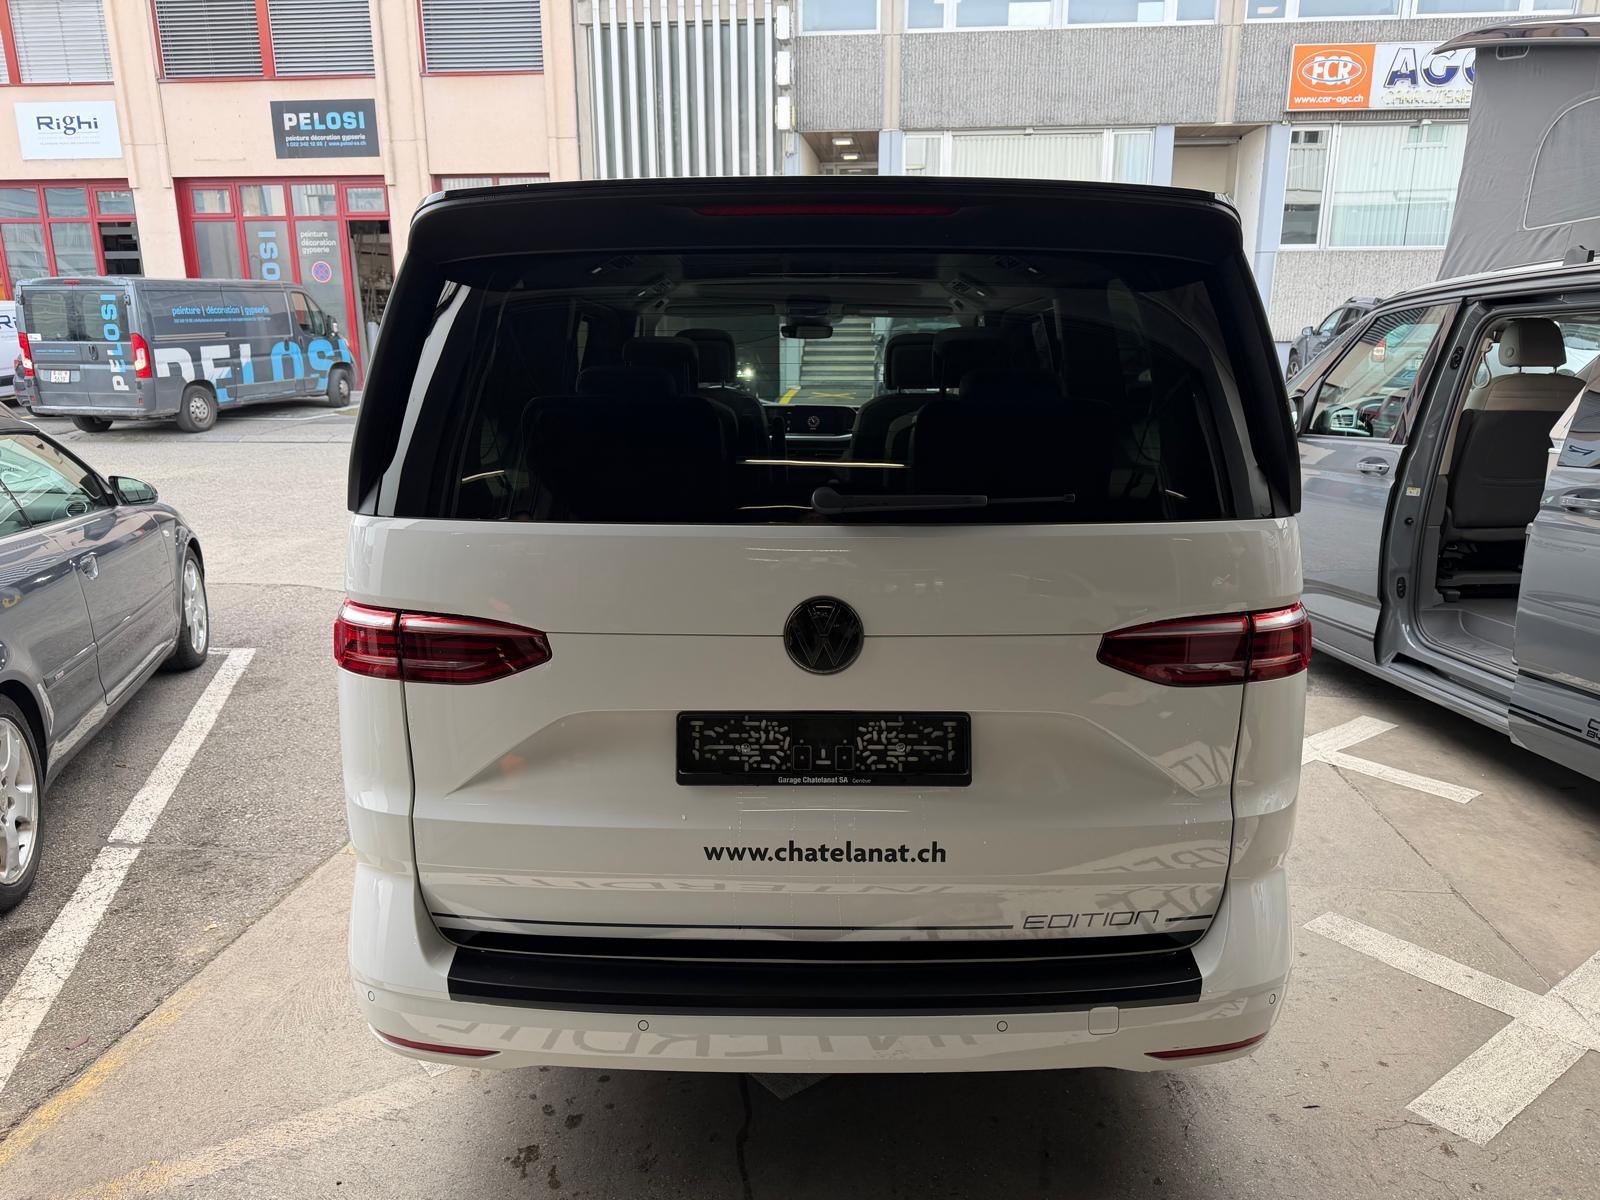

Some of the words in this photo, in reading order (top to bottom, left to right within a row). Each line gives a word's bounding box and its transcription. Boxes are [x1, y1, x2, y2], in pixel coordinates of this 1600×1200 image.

[1294, 94, 1364, 105] www.car-agc.ch
[36, 115, 99, 136] Righi
[283, 111, 365, 131] PELOSI
[300, 231, 329, 239] peinture
[301, 239, 337, 247] décoration
[302, 246, 330, 255] gypserie
[172, 306, 201, 317] peinture
[206, 305, 240, 315] décoration
[100, 294, 130, 391] PELOSI
[778, 776, 802, 785] Garage
[802, 776, 838, 784] Chatelanat
[838, 776, 849, 784] SA
[703, 840, 946, 863] www.chatelanat.ch
[1022, 909, 1160, 930] EDITION
